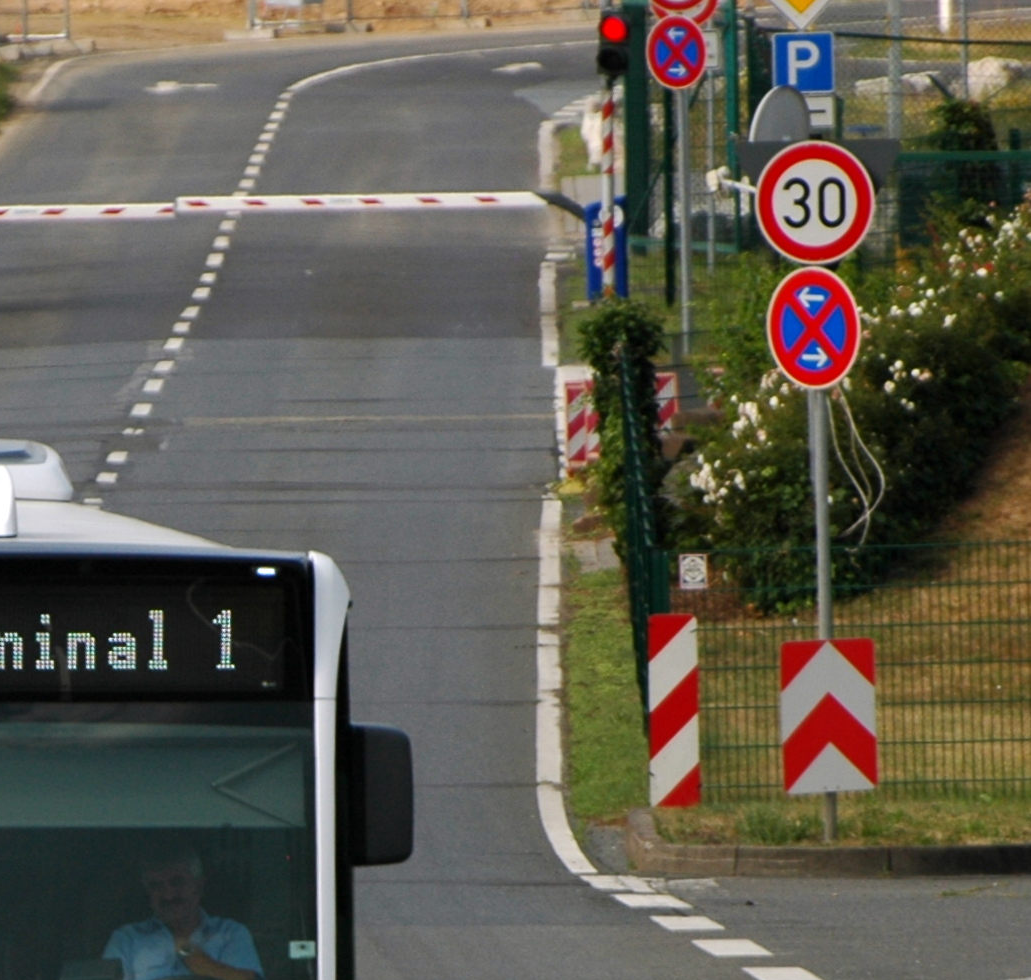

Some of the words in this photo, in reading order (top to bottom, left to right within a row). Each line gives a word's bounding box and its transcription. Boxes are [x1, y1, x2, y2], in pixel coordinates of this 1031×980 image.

[787, 40, 820, 86] P
[783, 177, 846, 228] 30
[212, 609, 236, 670] 1
